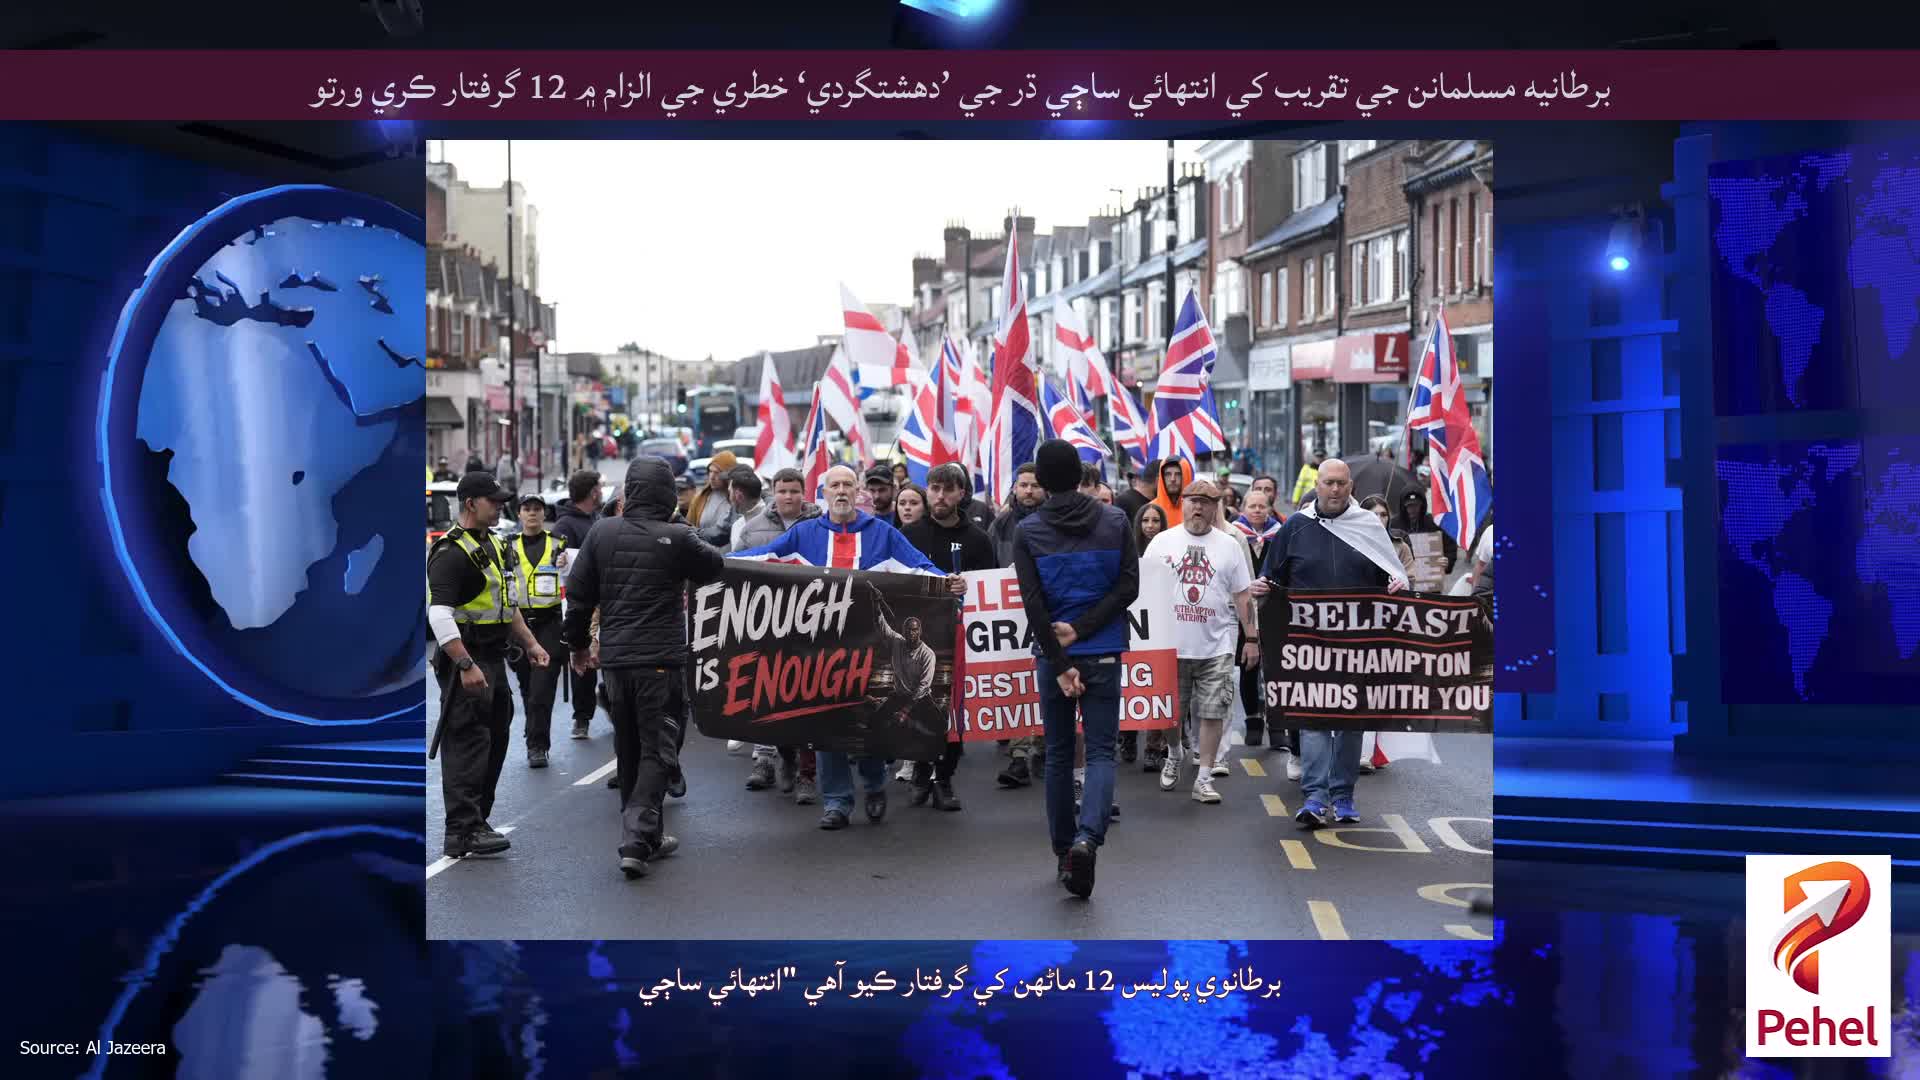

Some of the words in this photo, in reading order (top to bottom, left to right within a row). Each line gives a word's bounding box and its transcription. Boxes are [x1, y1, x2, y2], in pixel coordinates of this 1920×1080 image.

[691, 574, 855, 652] ENOUGH
[1288, 601, 1479, 637] BELFAST
[1281, 643, 1471, 678] SOUTHAMPTON
[721, 647, 875, 716] ENOUGH
[1267, 681, 1358, 710] STANDS
[1366, 684, 1430, 711] WITH
[1438, 685, 1491, 711] YOU
